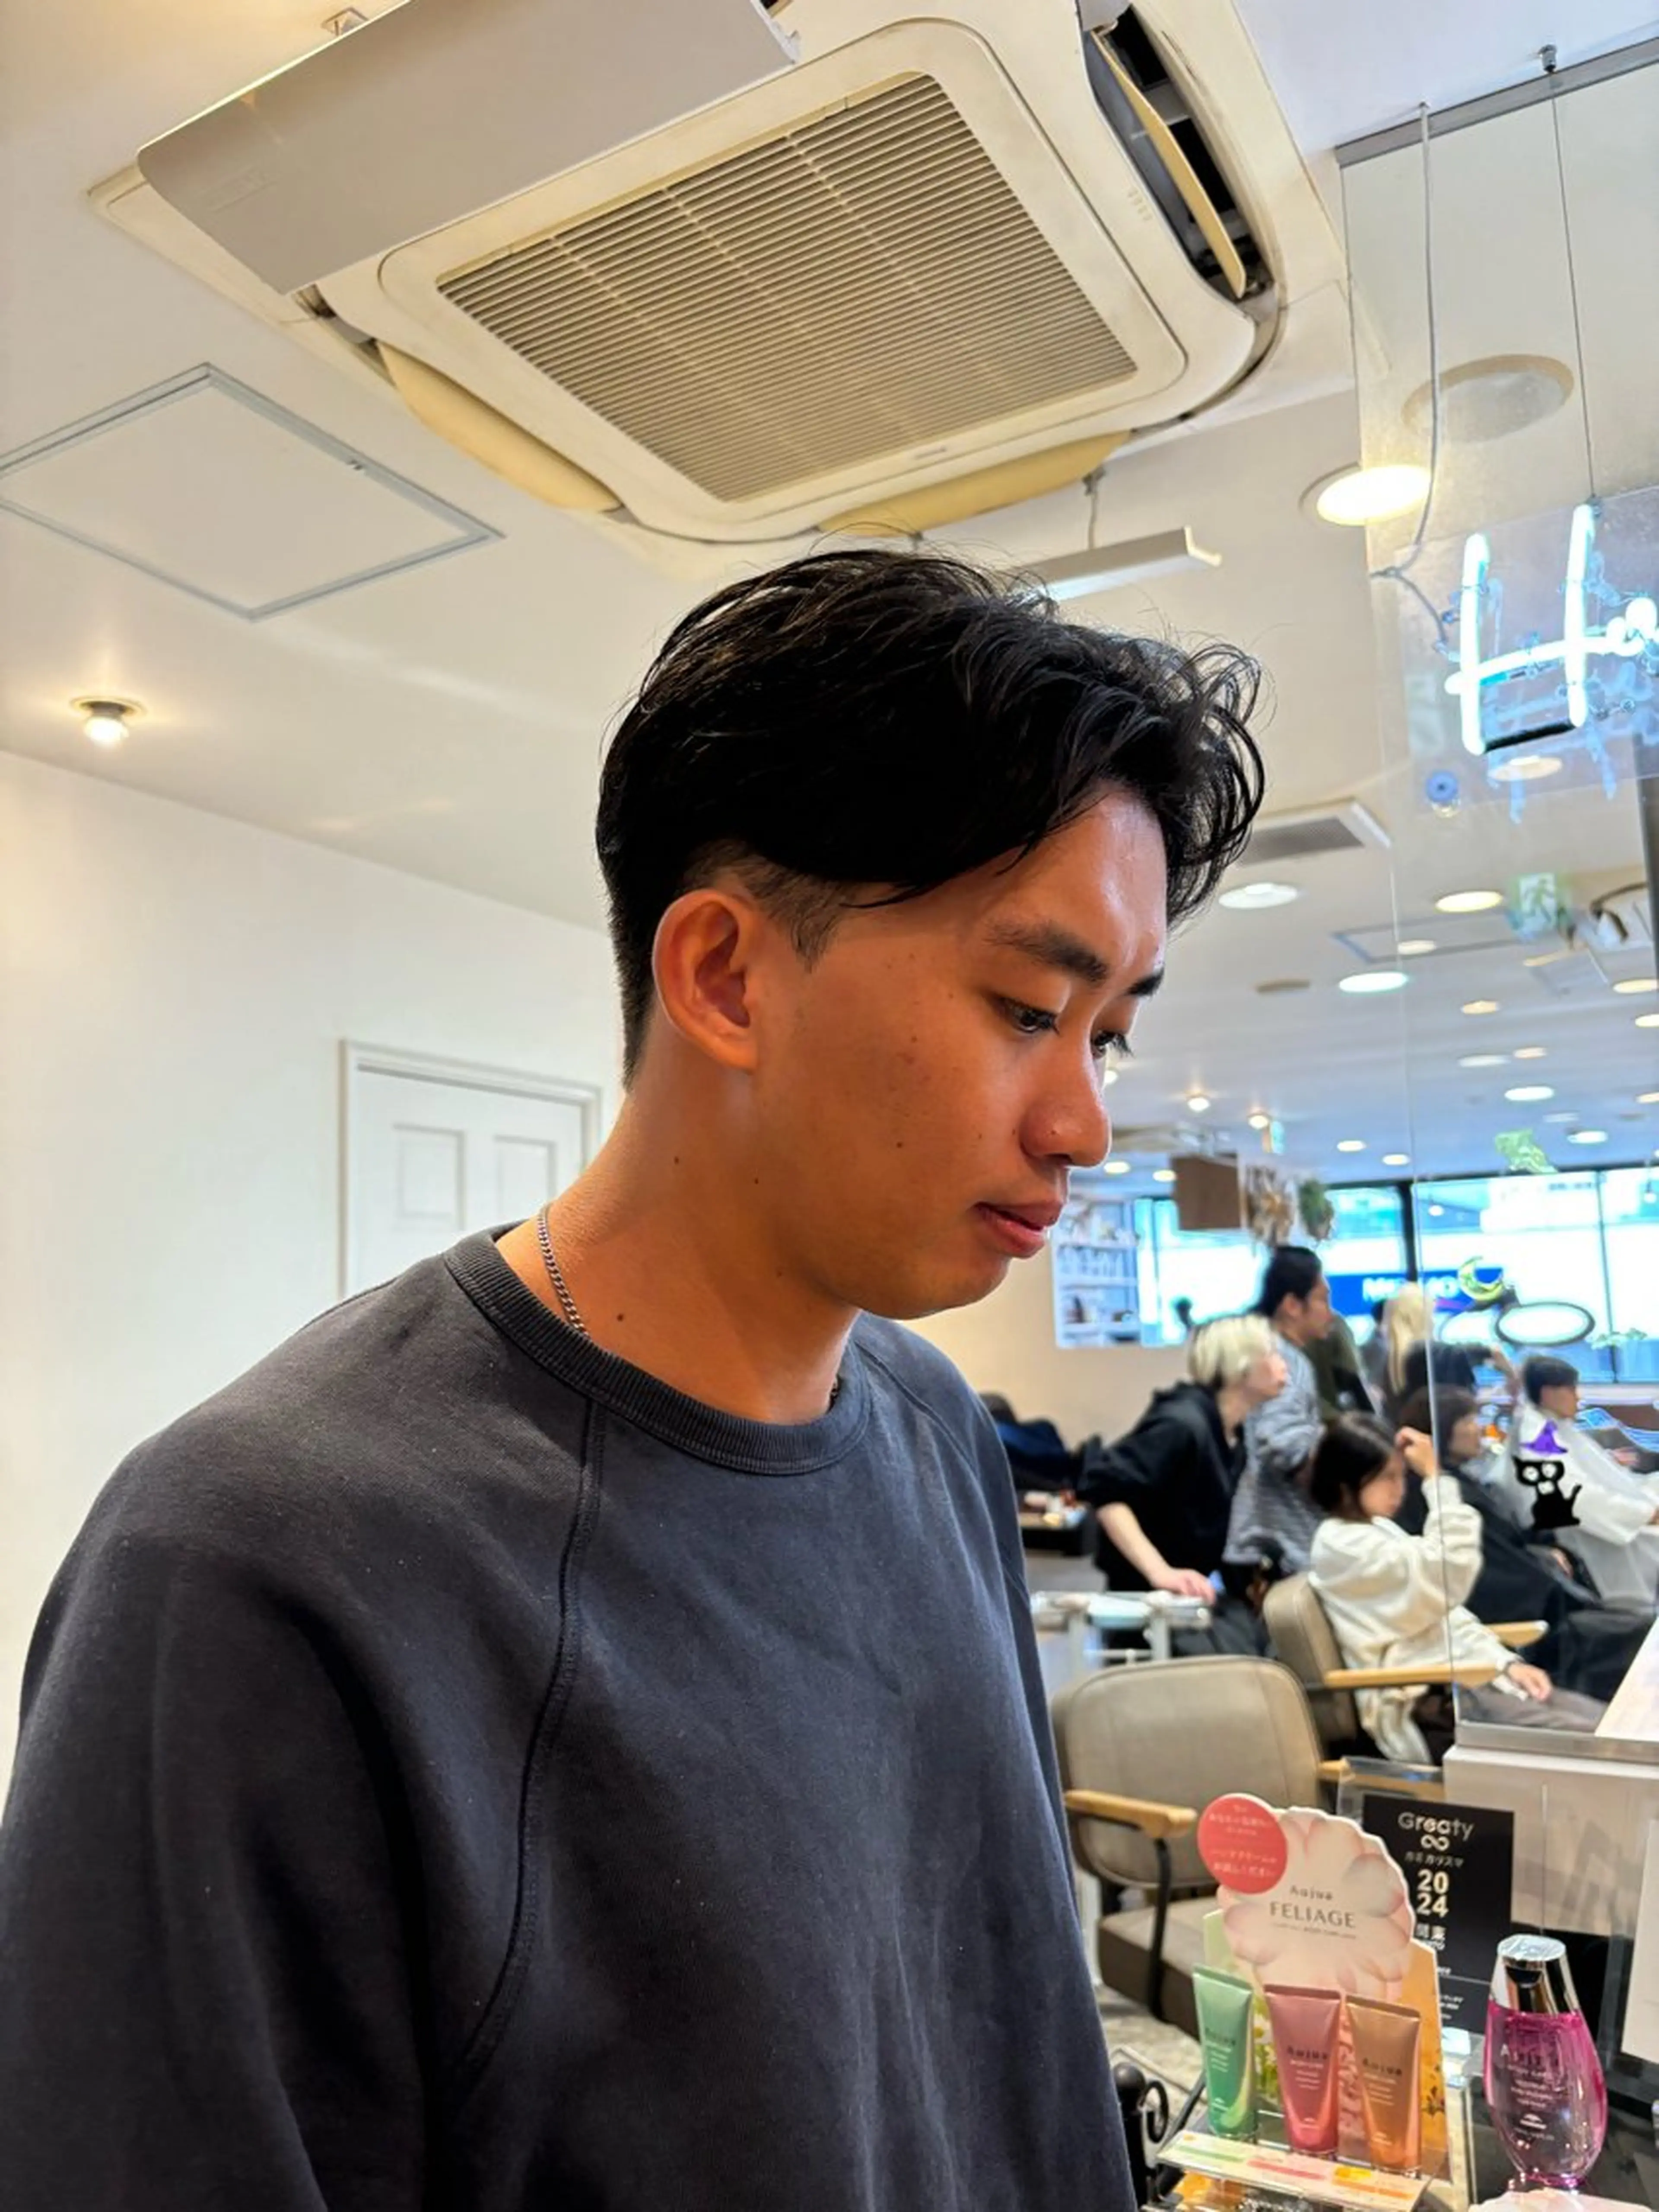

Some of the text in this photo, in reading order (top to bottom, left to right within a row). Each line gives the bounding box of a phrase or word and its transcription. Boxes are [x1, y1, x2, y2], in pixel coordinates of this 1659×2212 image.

[1417, 1869, 1449, 1894] 20
[1269, 1900, 1356, 1929] FELIAGE
[1416, 1892, 1449, 1918] 24
